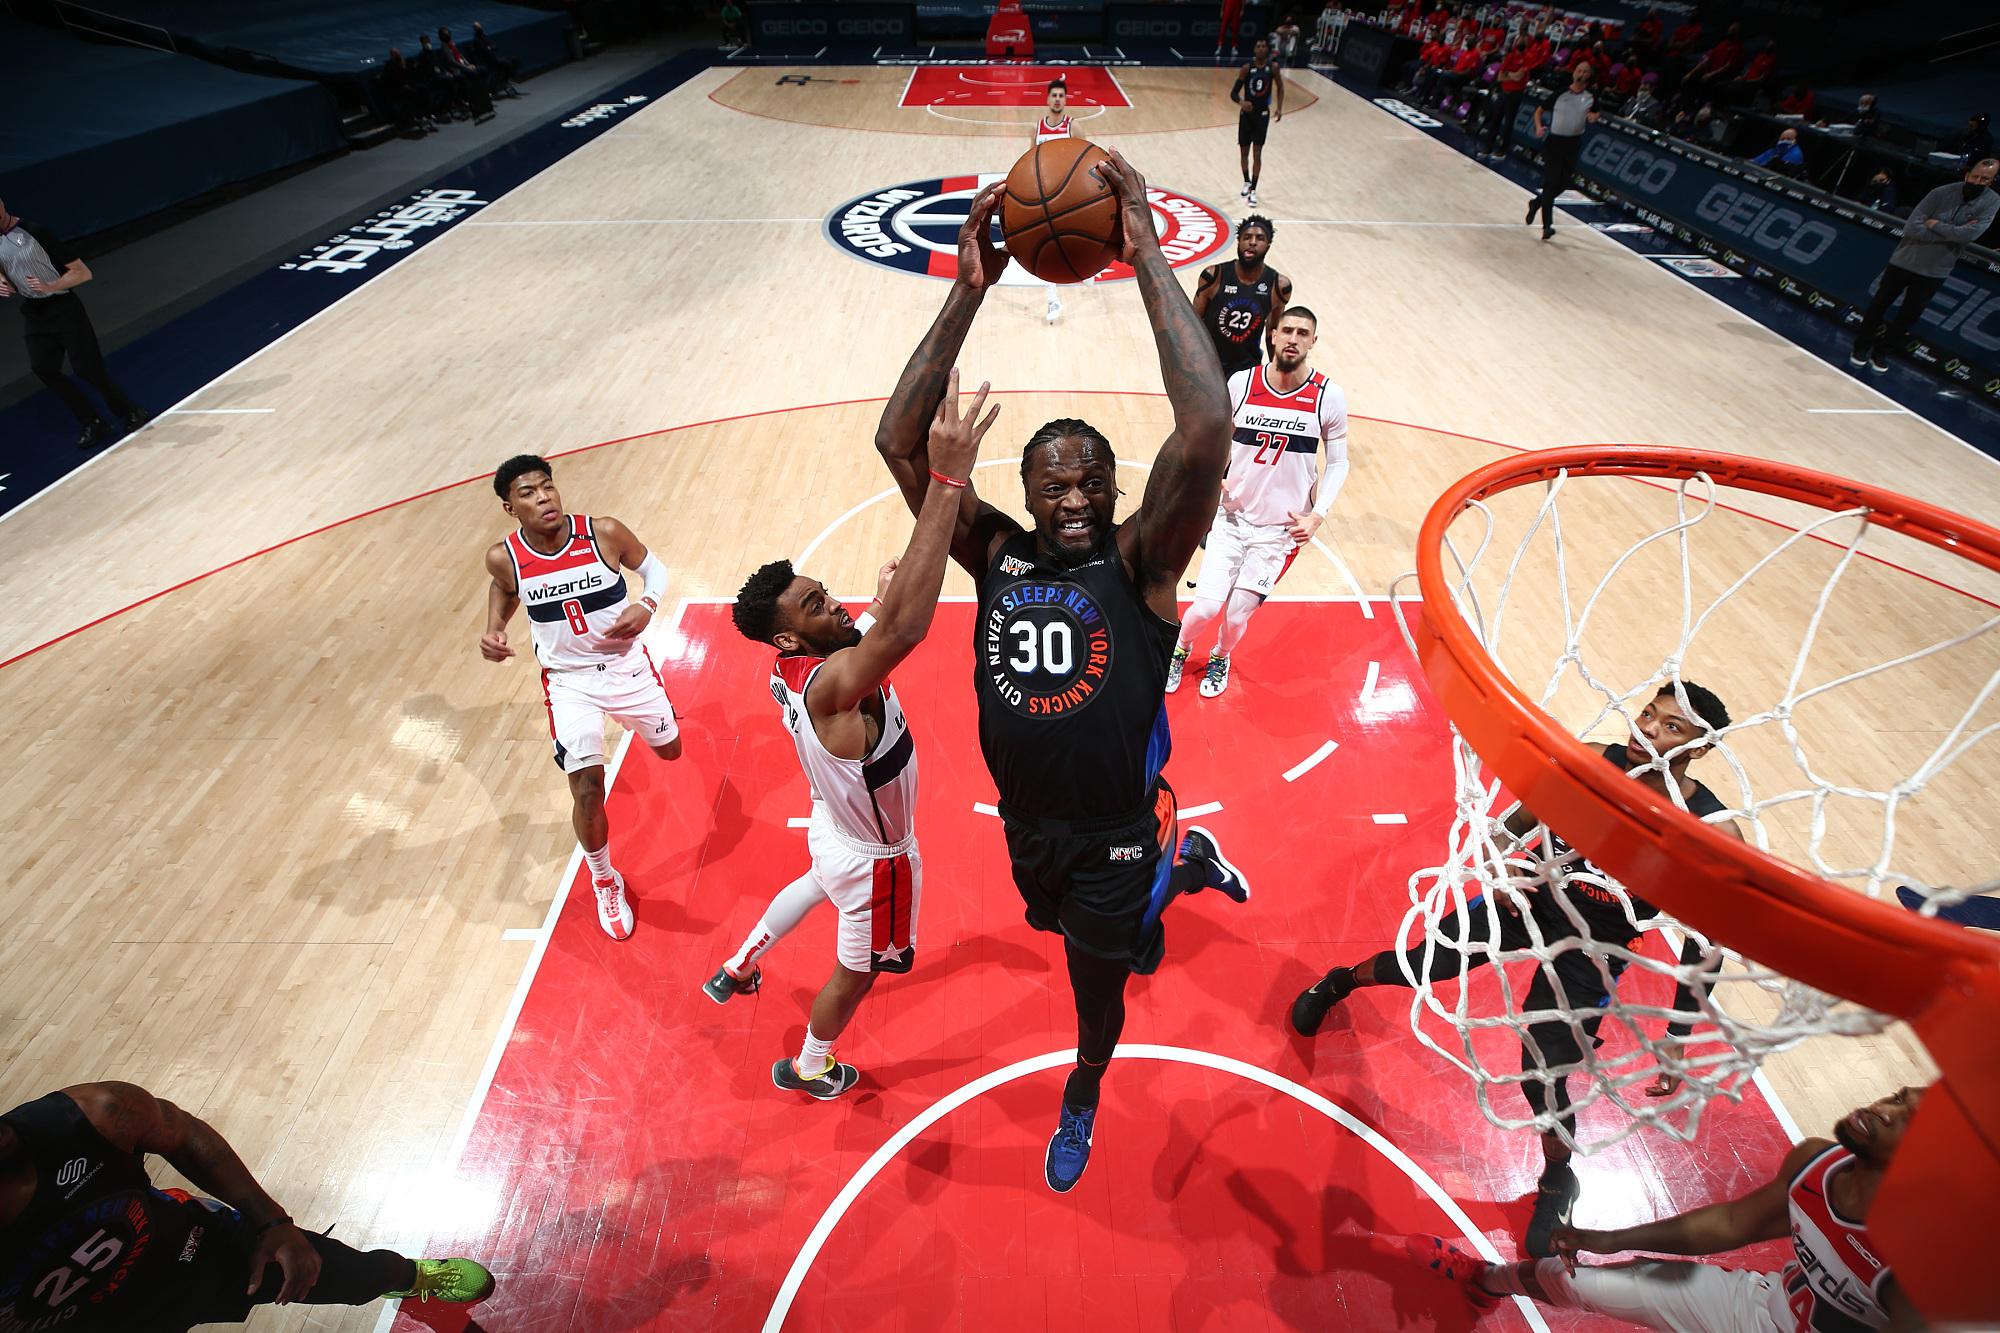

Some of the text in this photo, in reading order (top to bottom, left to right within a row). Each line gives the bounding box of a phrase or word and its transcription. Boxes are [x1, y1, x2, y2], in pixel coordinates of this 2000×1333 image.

[762, 19, 904, 35] GEICO GEICO
[1116, 20, 1181, 36] GEICO
[1256, 79, 1263, 90] 9
[1373, 98, 1444, 128] GEICO
[1580, 133, 1677, 195] GEICO
[297, 188, 489, 273] district
[841, 188, 925, 259] WIZARDS
[1146, 187, 1218, 265] ASHINGTO
[1695, 180, 1837, 264] GEICO
[1229, 311, 1252, 329] 23
[1245, 413, 1308, 432] wizards
[1253, 432, 1289, 466] 27
[528, 571, 602, 601] wizards
[562, 599, 589, 637] 8
[988, 586, 1107, 714] CITY NEVER SLEEPS NEW YORK KNICKS
[1009, 620, 1073, 675] 30
[655, 719, 669, 735] dc
[1109, 845, 1143, 861] NYC
[32, 1228, 123, 1307] 25
[1846, 1233, 1882, 1268] GEICO
